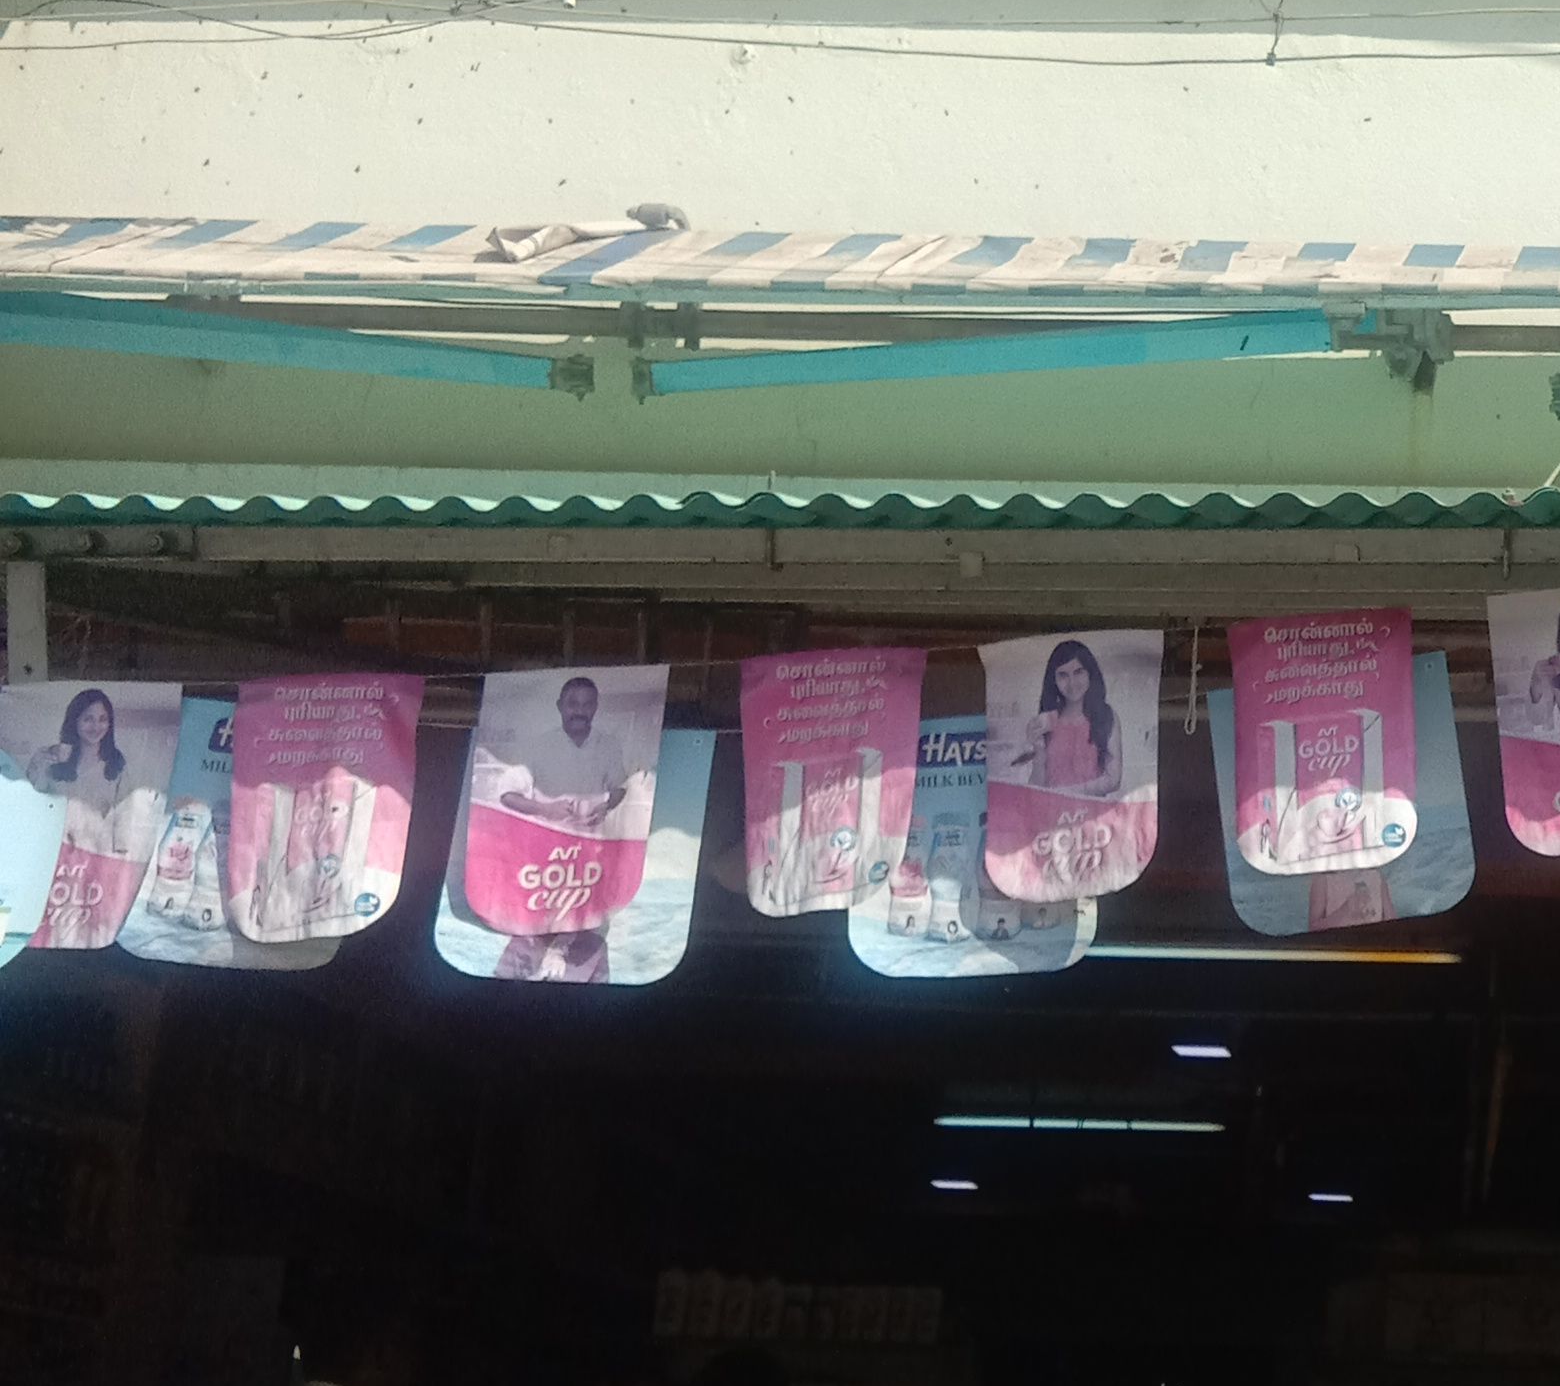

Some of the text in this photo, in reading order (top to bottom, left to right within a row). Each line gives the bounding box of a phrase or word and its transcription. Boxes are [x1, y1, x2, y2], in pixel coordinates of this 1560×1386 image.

[922, 732, 988, 767] HATS
[1298, 736, 1360, 758] GOLD
[201, 759, 233, 774] MIL
[1033, 823, 1113, 855] GOLD
[518, 861, 602, 890] GOLD
[50, 881, 103, 906] OLD
[527, 887, 591, 921] cup
